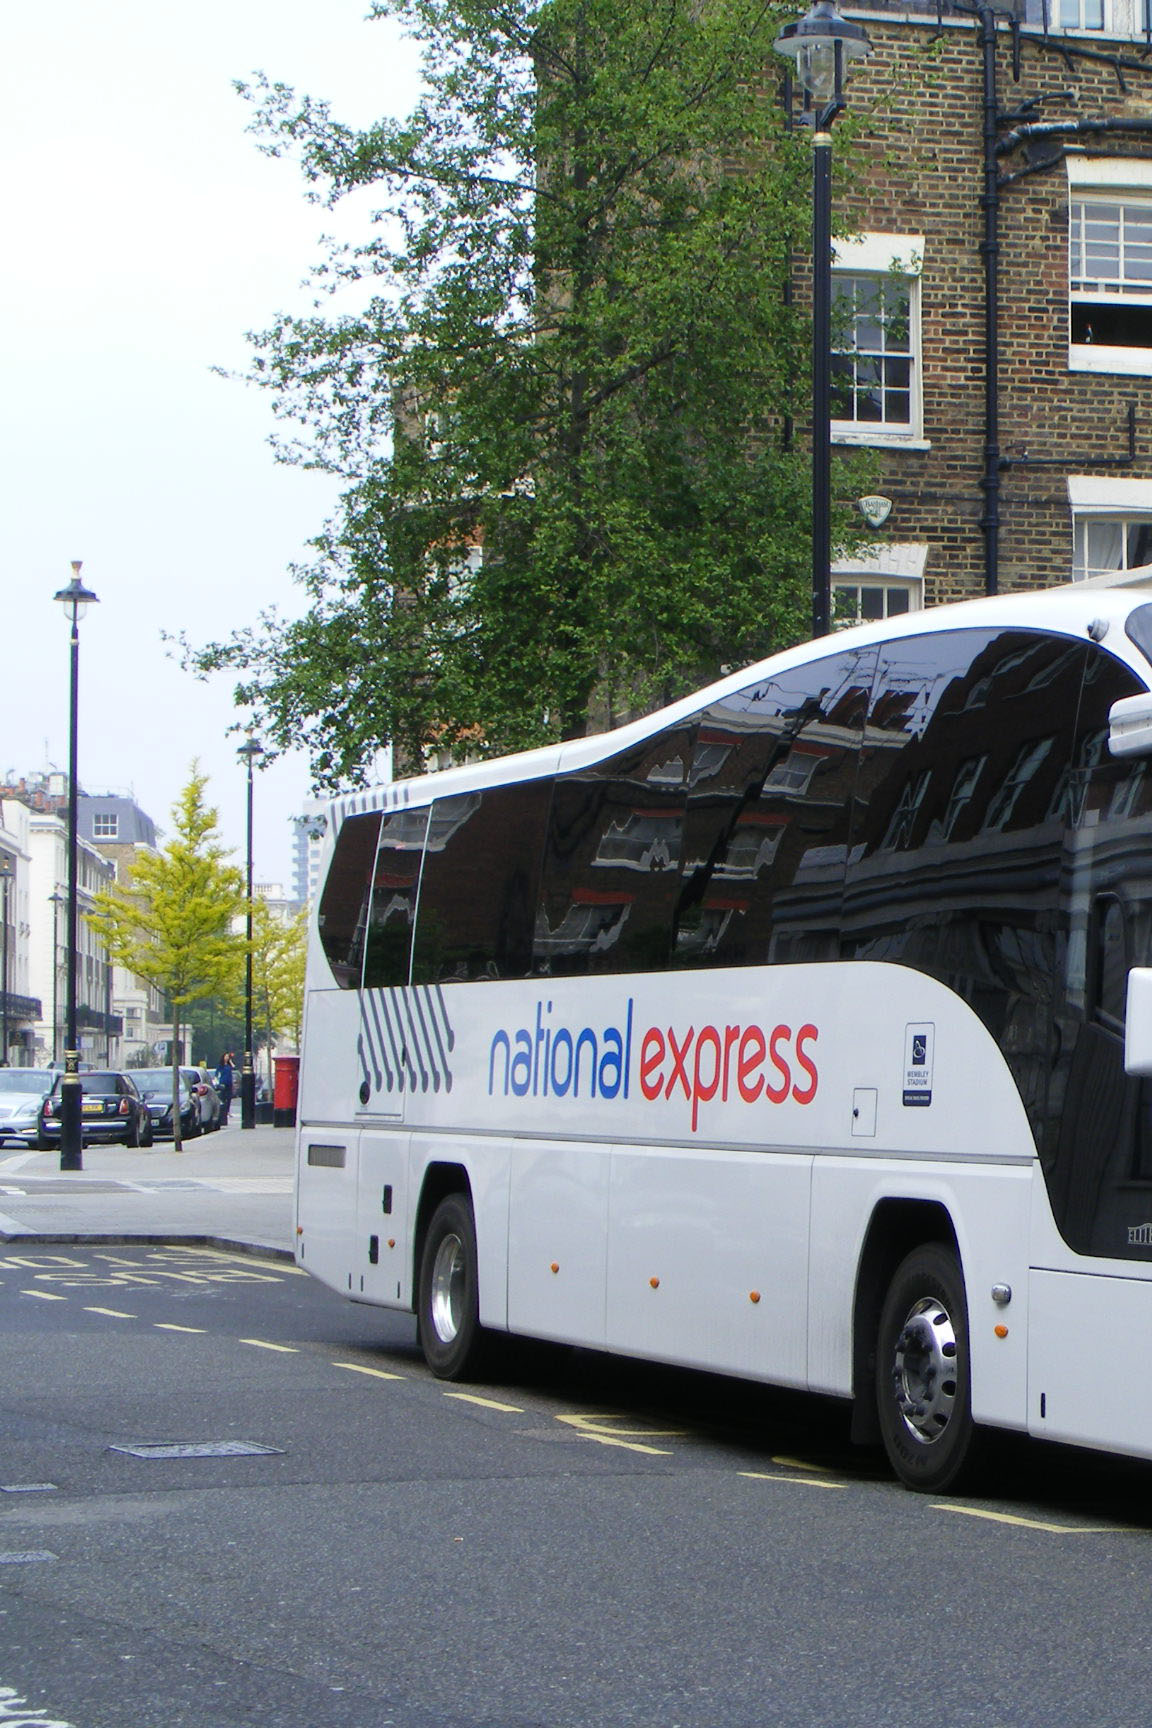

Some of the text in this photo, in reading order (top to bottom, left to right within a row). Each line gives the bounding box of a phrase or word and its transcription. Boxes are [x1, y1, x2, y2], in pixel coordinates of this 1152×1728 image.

[488, 997, 819, 1133] national express
[34, 1269, 285, 1287] BUS
